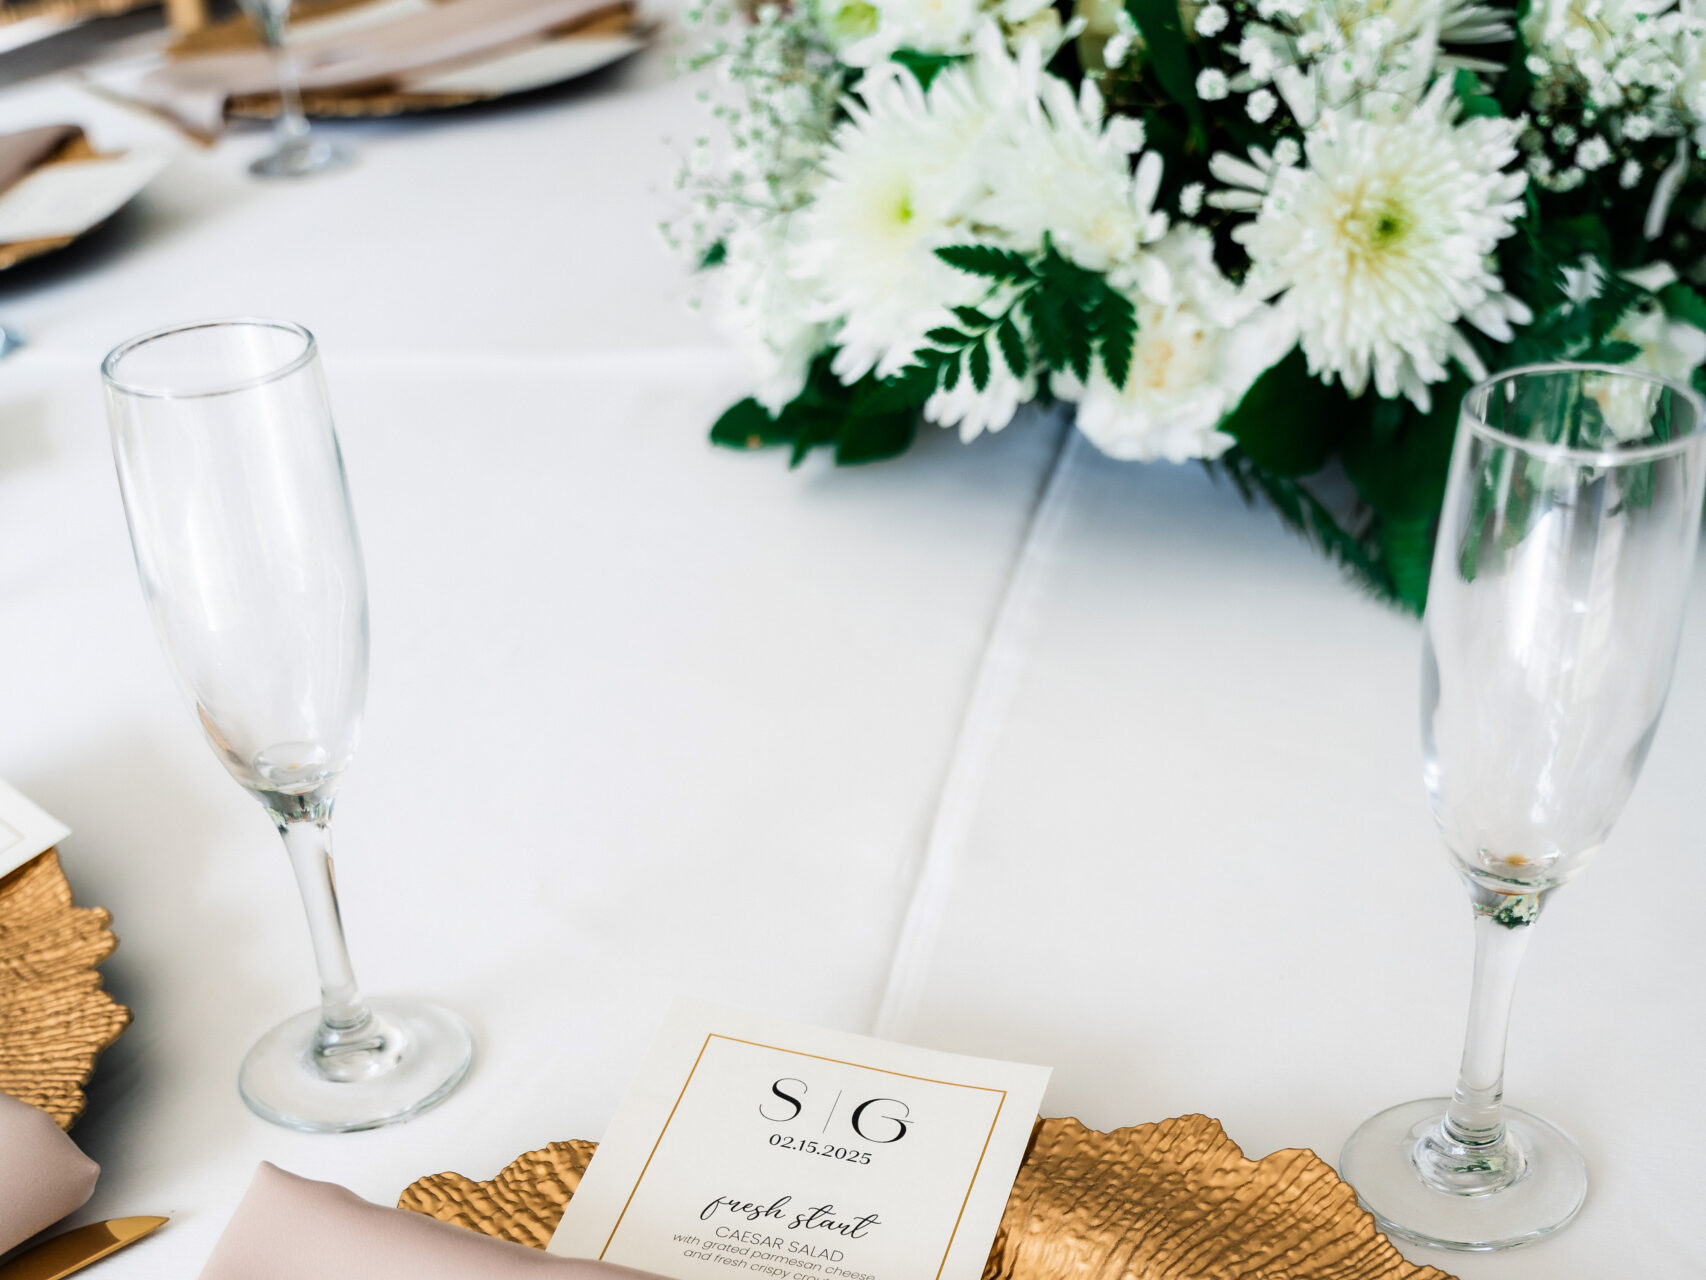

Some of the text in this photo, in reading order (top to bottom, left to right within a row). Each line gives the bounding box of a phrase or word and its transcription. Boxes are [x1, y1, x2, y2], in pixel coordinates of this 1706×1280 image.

[759, 1078, 808, 1122] S
[851, 1098, 914, 1144] G
[769, 1134, 872, 1165] 02.15.2025
[700, 1196, 882, 1239] fresh start
[673, 1232, 701, 1246] with
[701, 1239, 750, 1256] grated
[749, 1249, 822, 1272] parmesan
[715, 1226, 844, 1262] CAESAR SALAD
[683, 1247, 713, 1261] and
[714, 1253, 748, 1269] fresh
[750, 1261, 791, 1280] crispy
